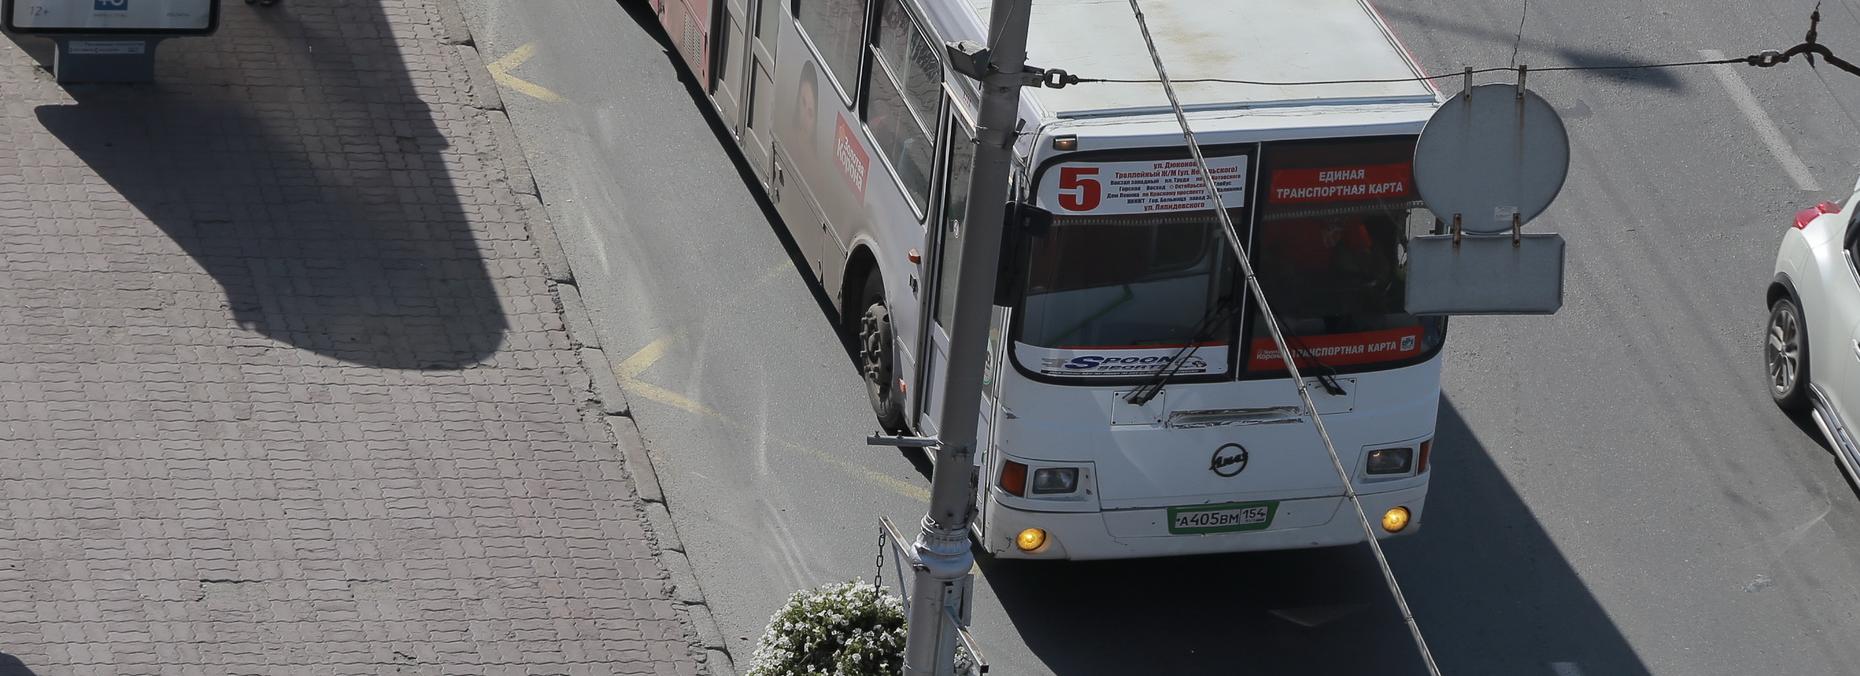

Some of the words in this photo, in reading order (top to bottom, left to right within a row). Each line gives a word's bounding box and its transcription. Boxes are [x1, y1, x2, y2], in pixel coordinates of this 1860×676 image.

[28, 6, 50, 17] 12+
[836, 138, 863, 192] Корона
[845, 136, 865, 176] Золотая
[1164, 161, 1198, 169] Дюконов
[1319, 169, 1365, 182] ЕДИНАЯ
[1058, 167, 1101, 212] 5
[1276, 184, 1365, 199] ТРАНСПОРТНАЯ
[1368, 181, 1403, 194] КАРТА
[1367, 342, 1396, 353] КАРТА
[1179, 511, 1240, 527] А405ВМ
[1242, 508, 1266, 519] 154
